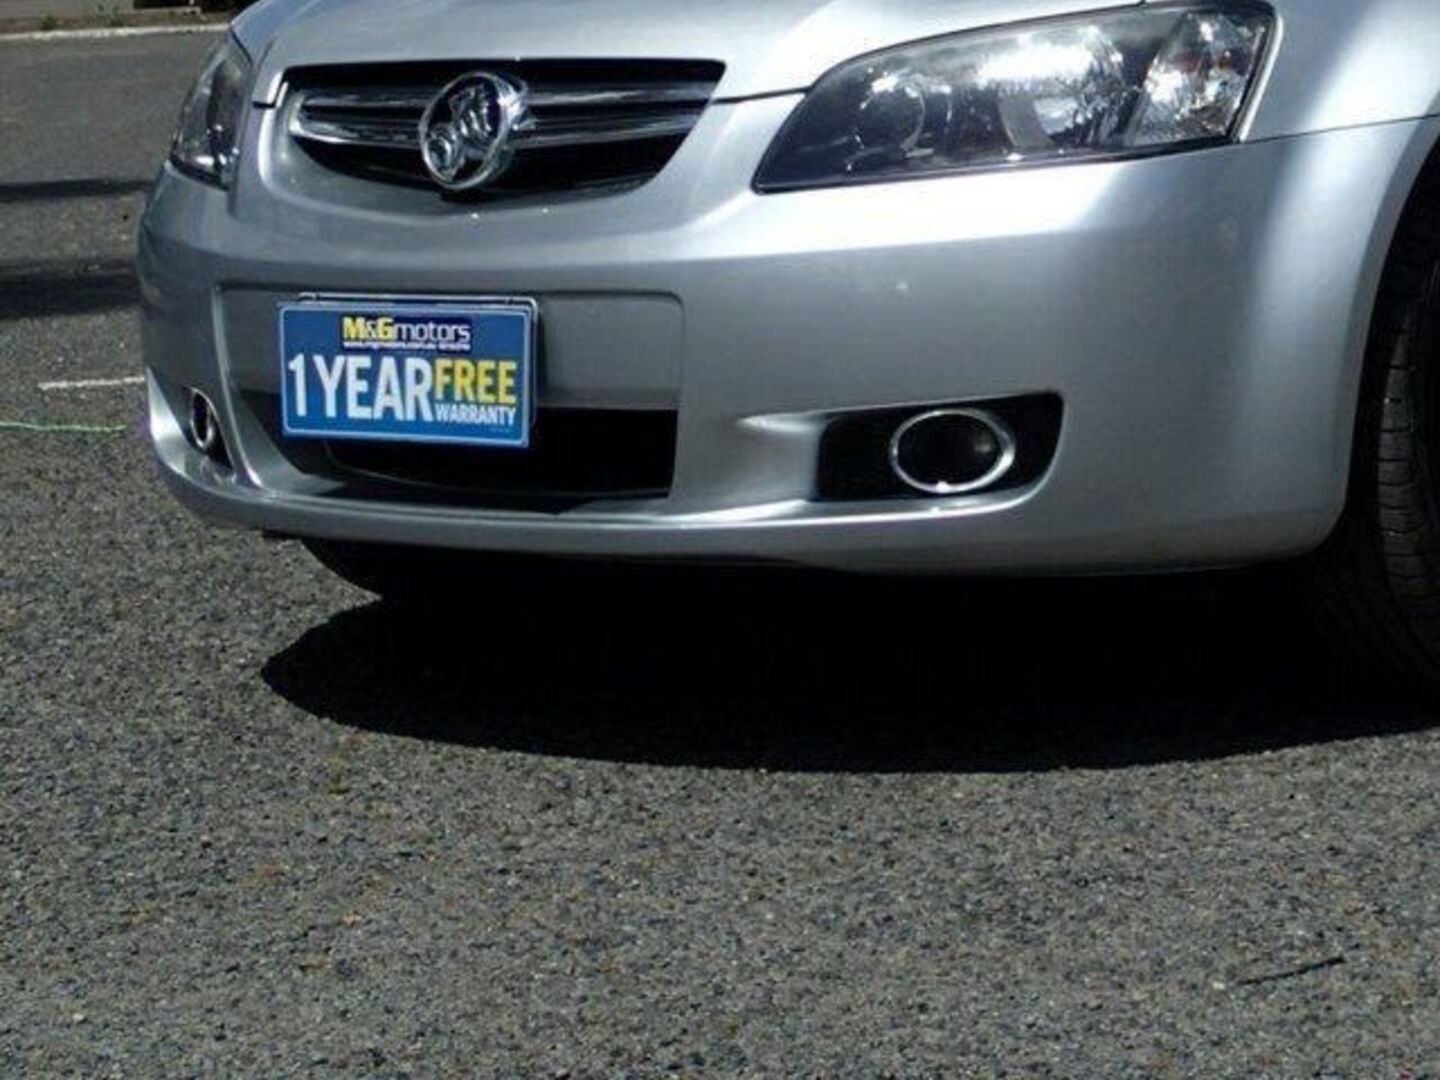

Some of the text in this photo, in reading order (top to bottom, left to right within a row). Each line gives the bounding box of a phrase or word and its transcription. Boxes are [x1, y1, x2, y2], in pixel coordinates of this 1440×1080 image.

[288, 353, 517, 422] 1 YEAR FREE
[435, 403, 516, 426] WARRANTY
